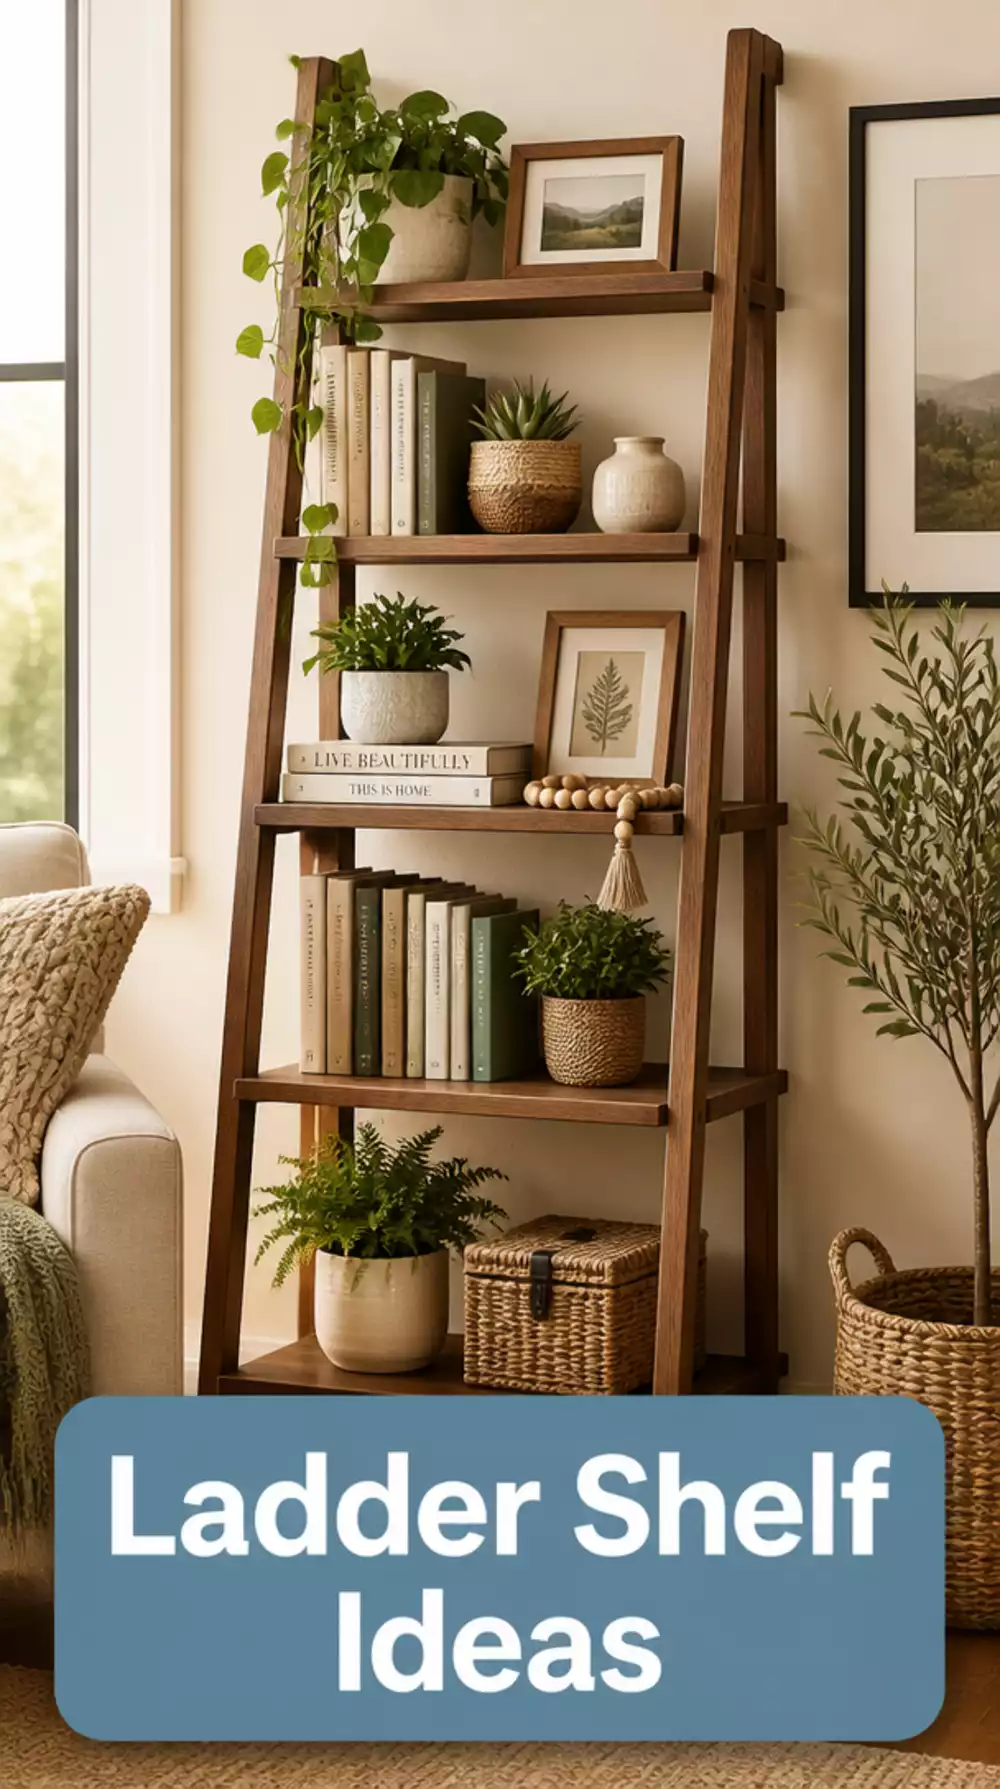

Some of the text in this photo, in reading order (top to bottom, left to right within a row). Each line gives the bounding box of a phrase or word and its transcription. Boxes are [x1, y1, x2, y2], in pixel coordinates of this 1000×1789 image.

[314, 751, 472, 770] LIVE BEAUTIFULLY
[348, 782, 432, 797] THIS IS HOME
